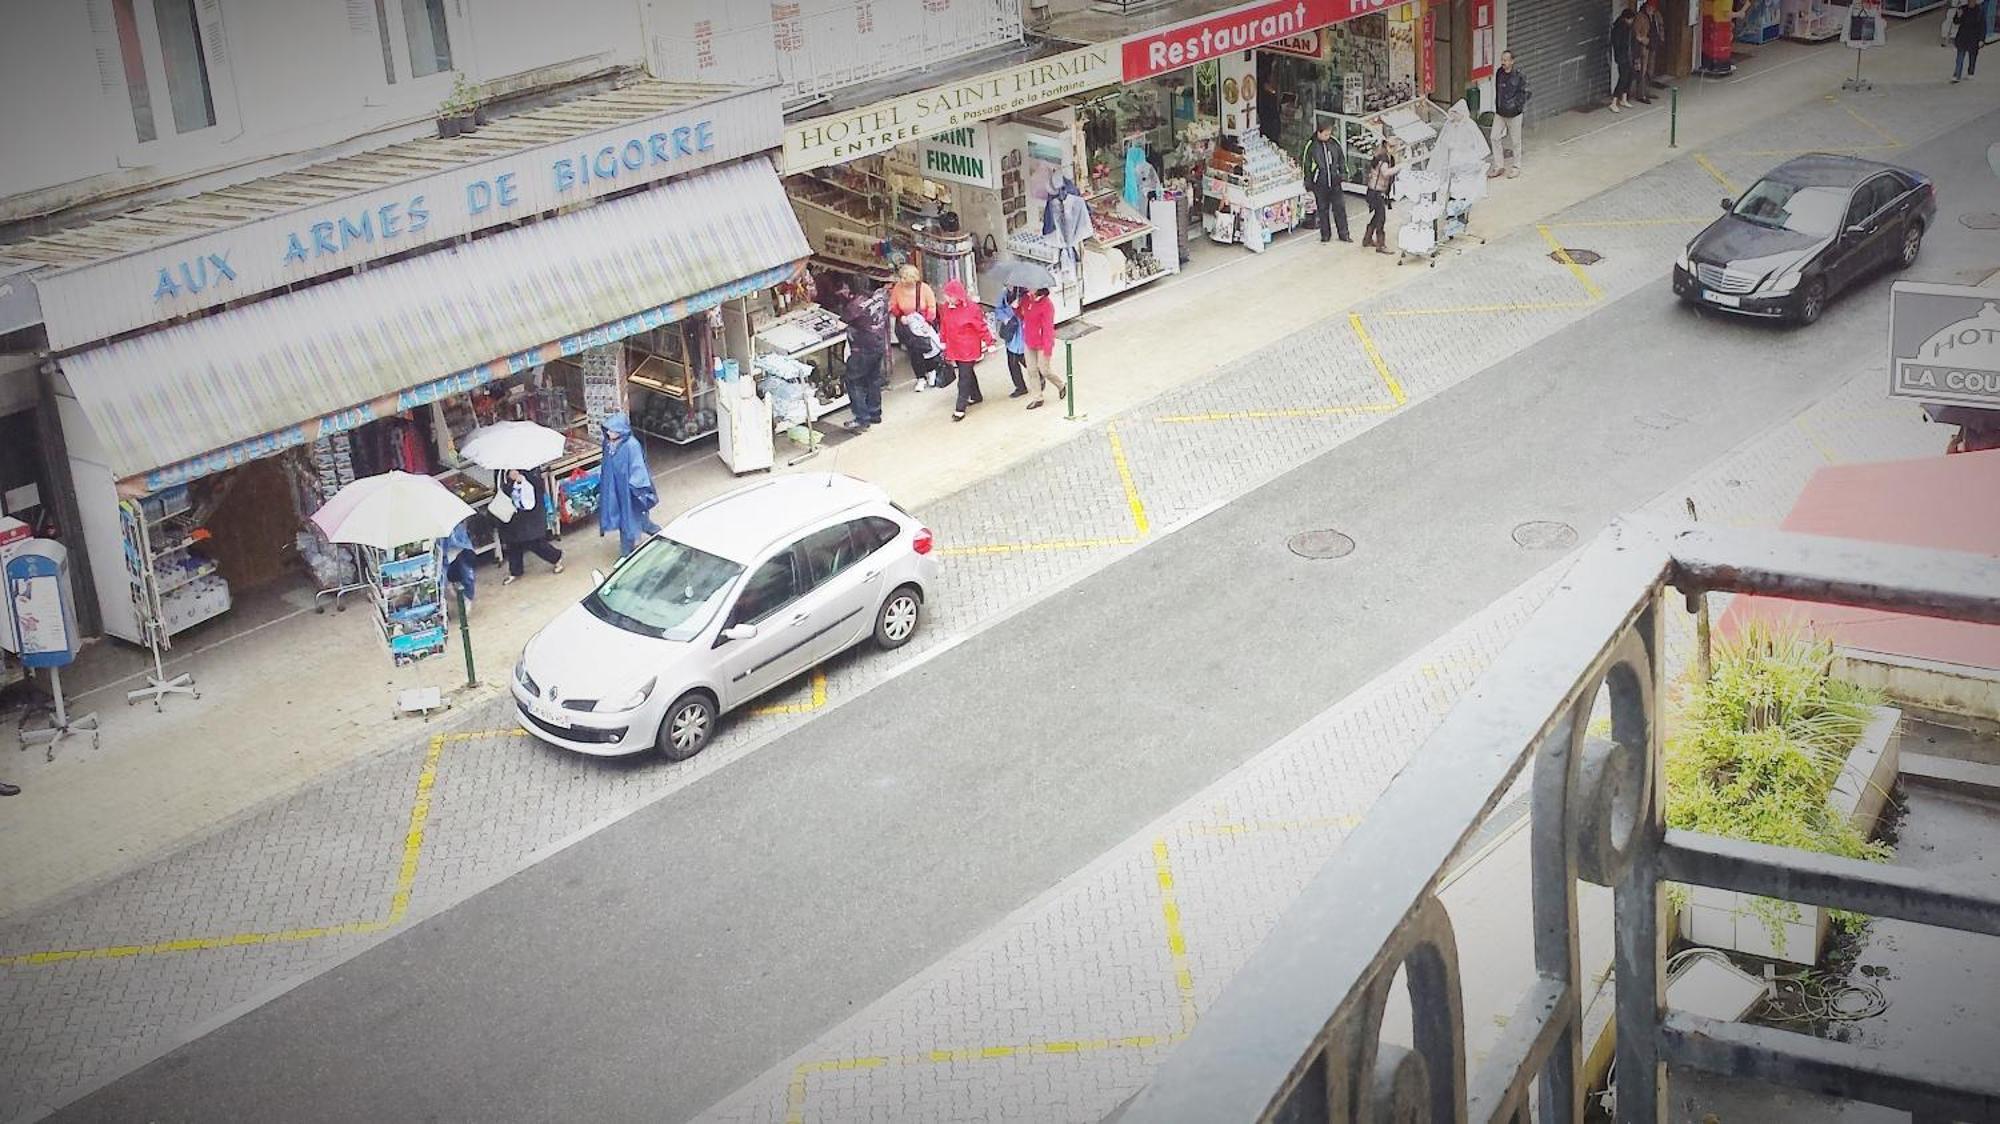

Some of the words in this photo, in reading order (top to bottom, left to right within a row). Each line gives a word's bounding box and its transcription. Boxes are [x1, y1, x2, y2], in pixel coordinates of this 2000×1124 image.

[1148, 2, 1307, 70] Restaurant
[799, 106, 905, 150] HOTEL
[916, 76, 1006, 119] SAINT
[1012, 48, 1110, 92] FIRMIN
[834, 124, 921, 157] ENTREE
[963, 102, 1007, 121] Passage
[1011, 97, 1024, 108] de
[1027, 92, 1037, 102] la
[1041, 80, 1086, 98] Fontaine
[926, 149, 984, 179] FIRMIN
[153, 250, 237, 302] AUX
[282, 195, 432, 267] ARMES
[466, 171, 518, 215] DE
[552, 120, 715, 193] BIGORRE
[1904, 367, 1936, 388] LA
